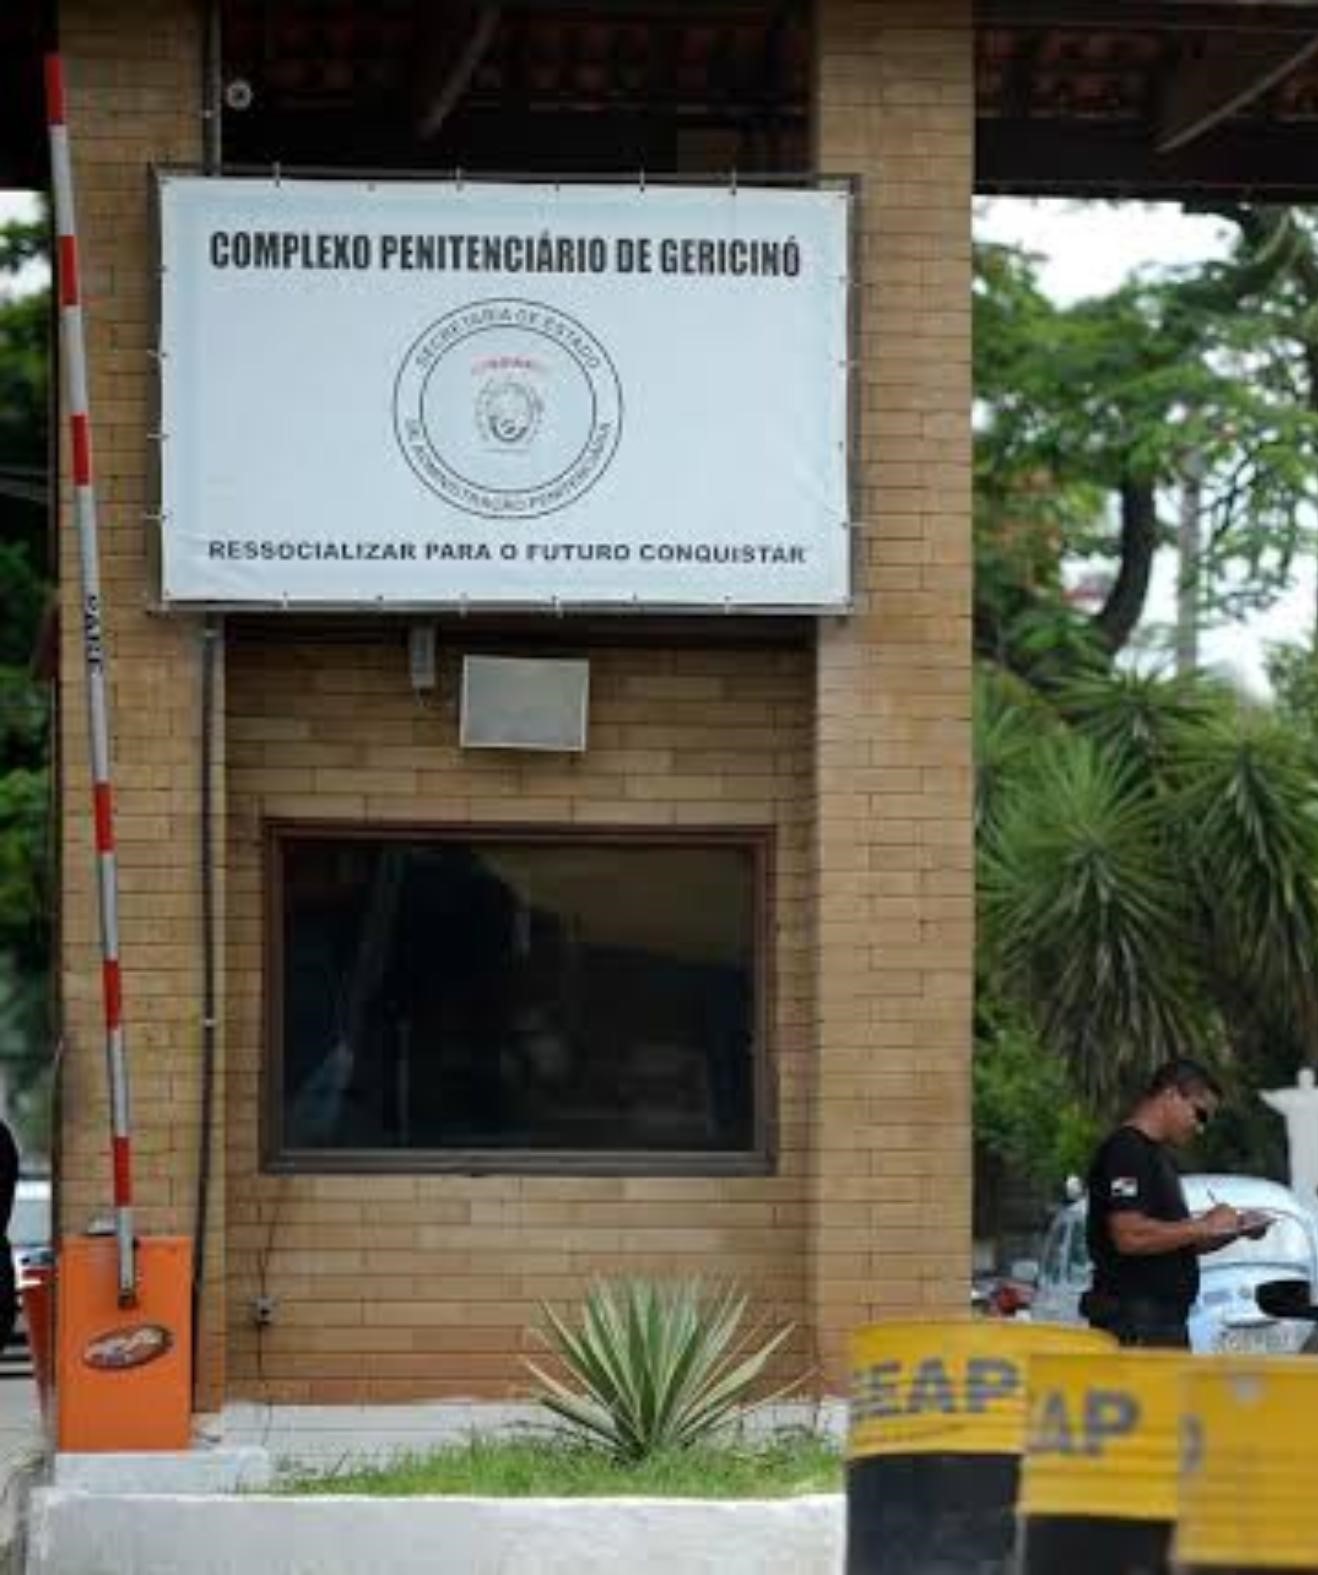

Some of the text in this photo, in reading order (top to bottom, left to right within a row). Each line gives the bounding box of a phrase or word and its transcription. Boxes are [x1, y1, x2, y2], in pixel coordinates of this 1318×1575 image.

[210, 228, 801, 277] COMPLEXO PENITENCIÁRIO DE GERICINÓ
[544, 318, 601, 370] ESTADO
[208, 540, 807, 564] RESSOCIALIZAR PARA O FUTURO CONQUISTAR
